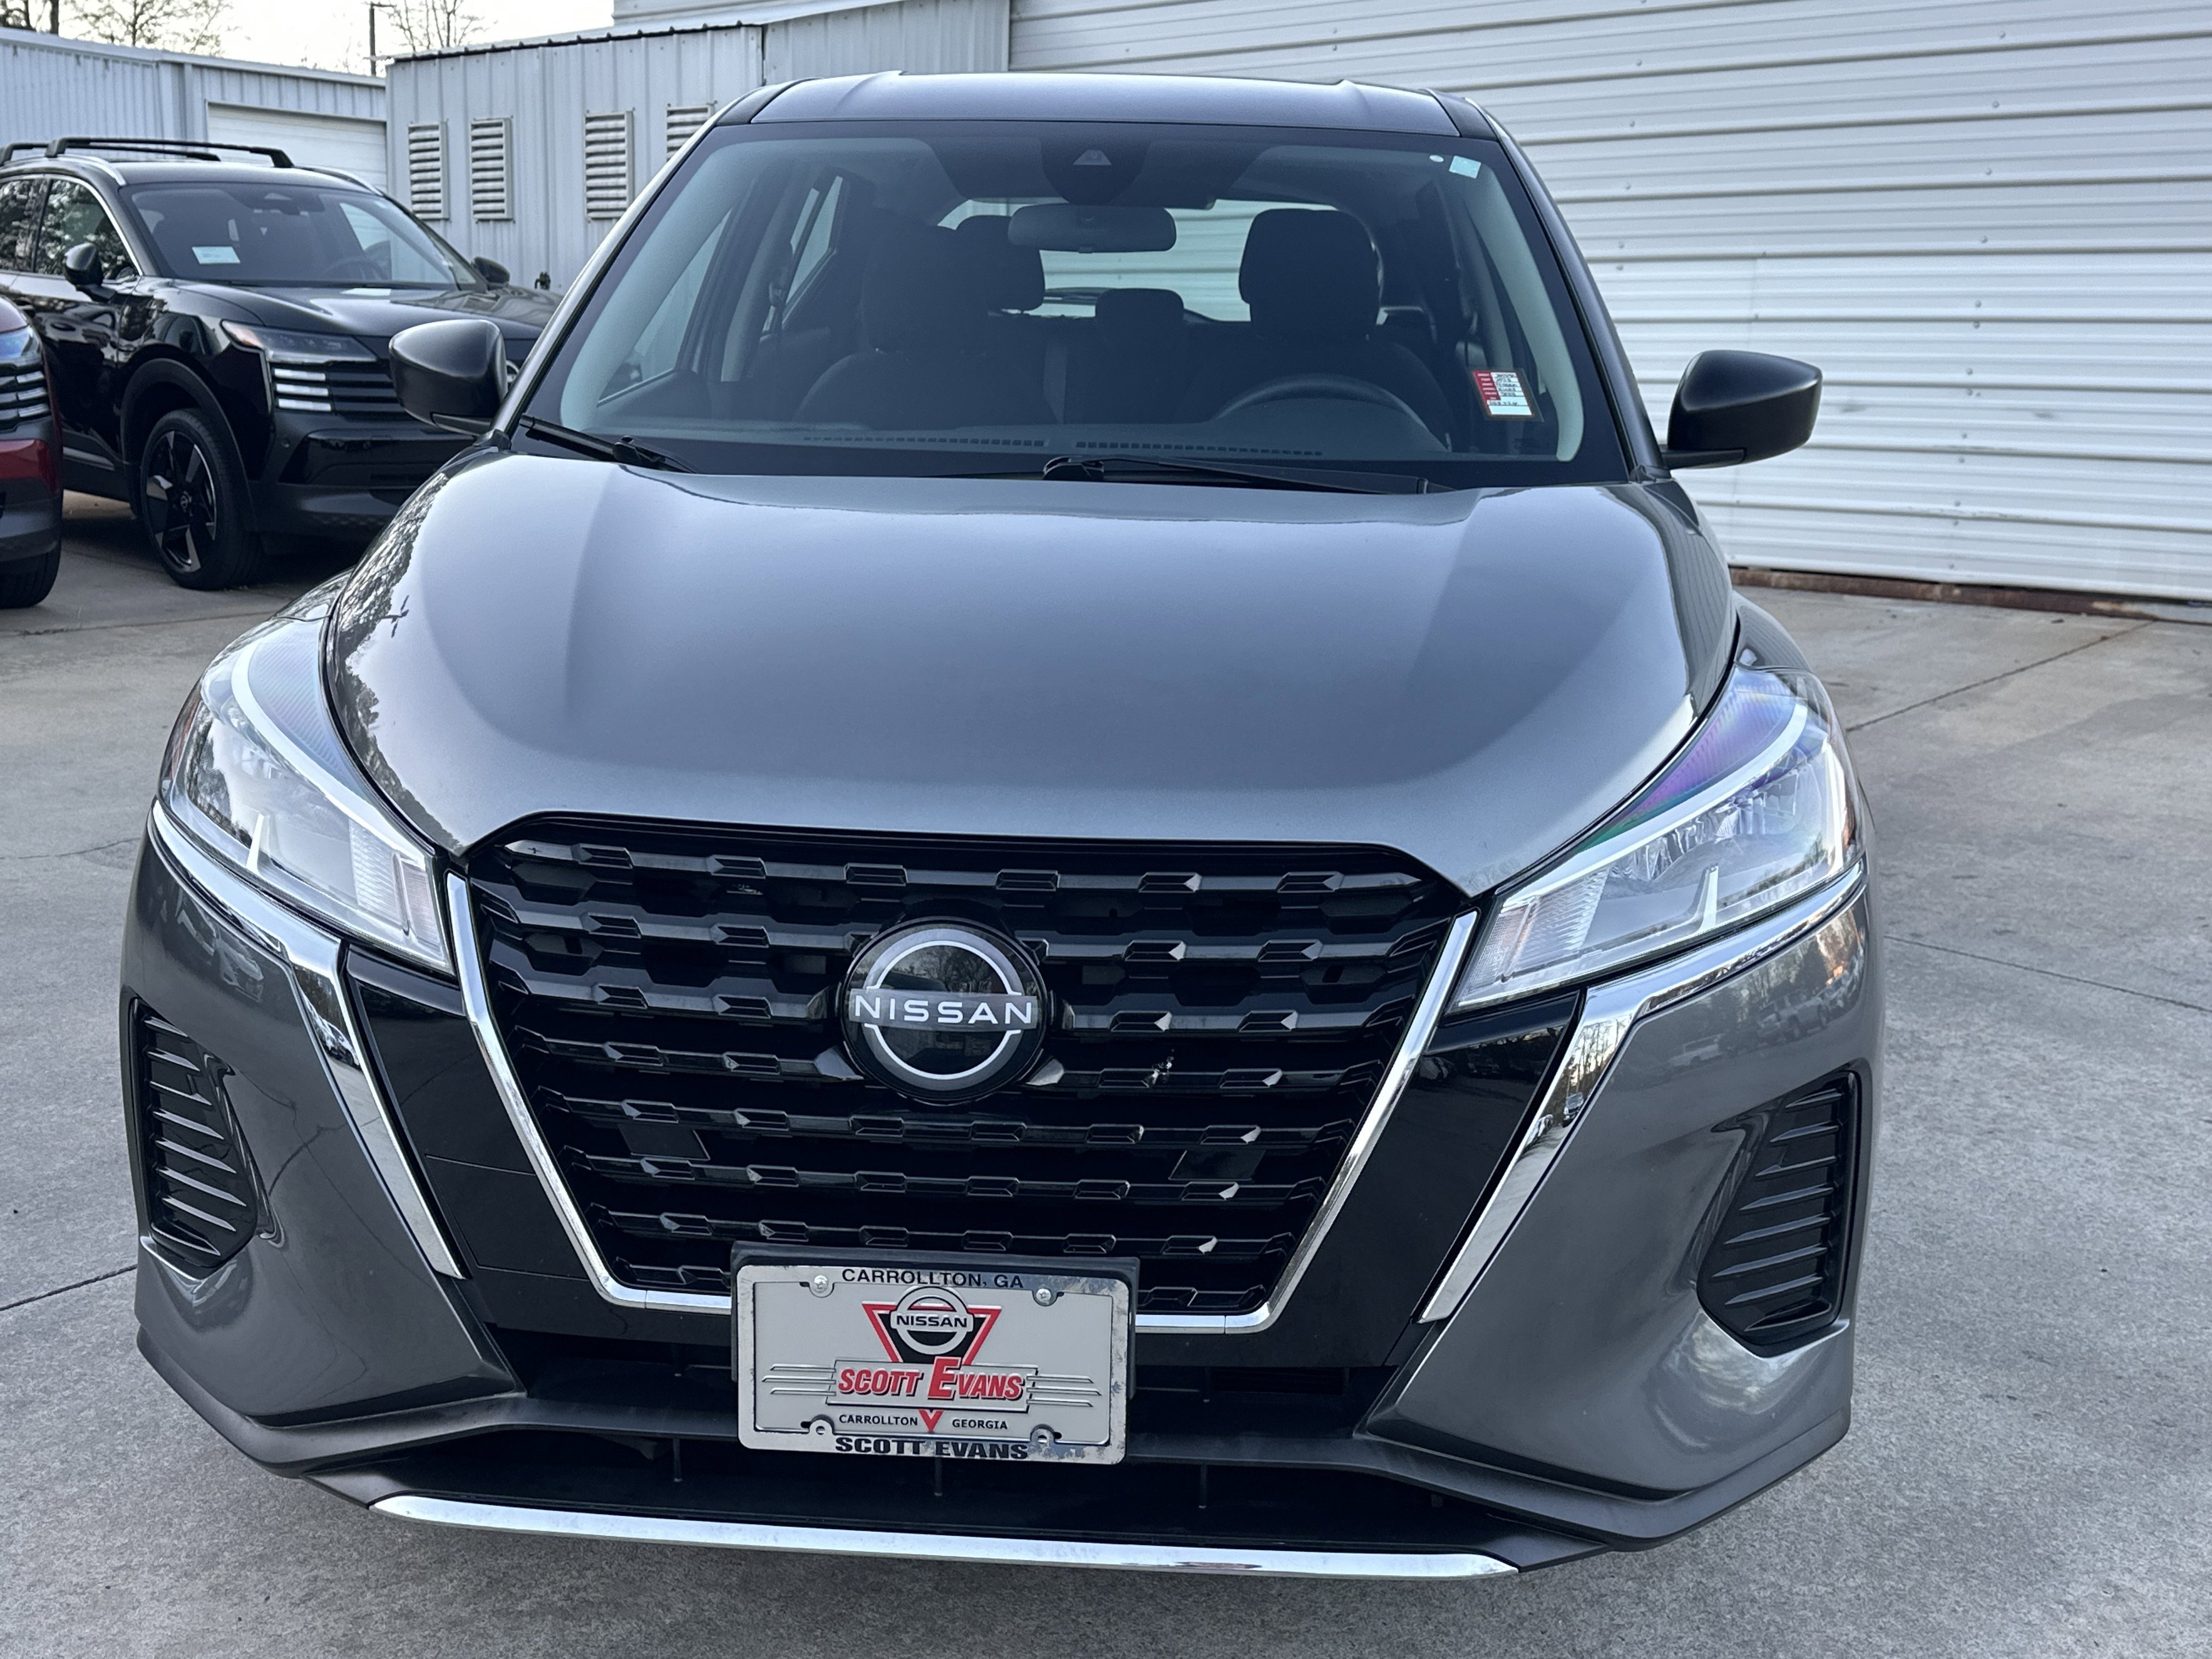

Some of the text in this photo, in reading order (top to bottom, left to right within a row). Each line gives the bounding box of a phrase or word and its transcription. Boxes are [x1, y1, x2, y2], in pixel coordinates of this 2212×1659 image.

[855, 995, 1032, 1024] NISSAN
[842, 1268, 1024, 1288] CARROLLTON, GA
[896, 1315, 967, 1328] NISSAN
[838, 1356, 1025, 1401] SCOTT EVANS
[839, 1414, 1008, 1430] CARROLLTON GEORGIA
[835, 1437, 1028, 1460] SCOTT EVANS
